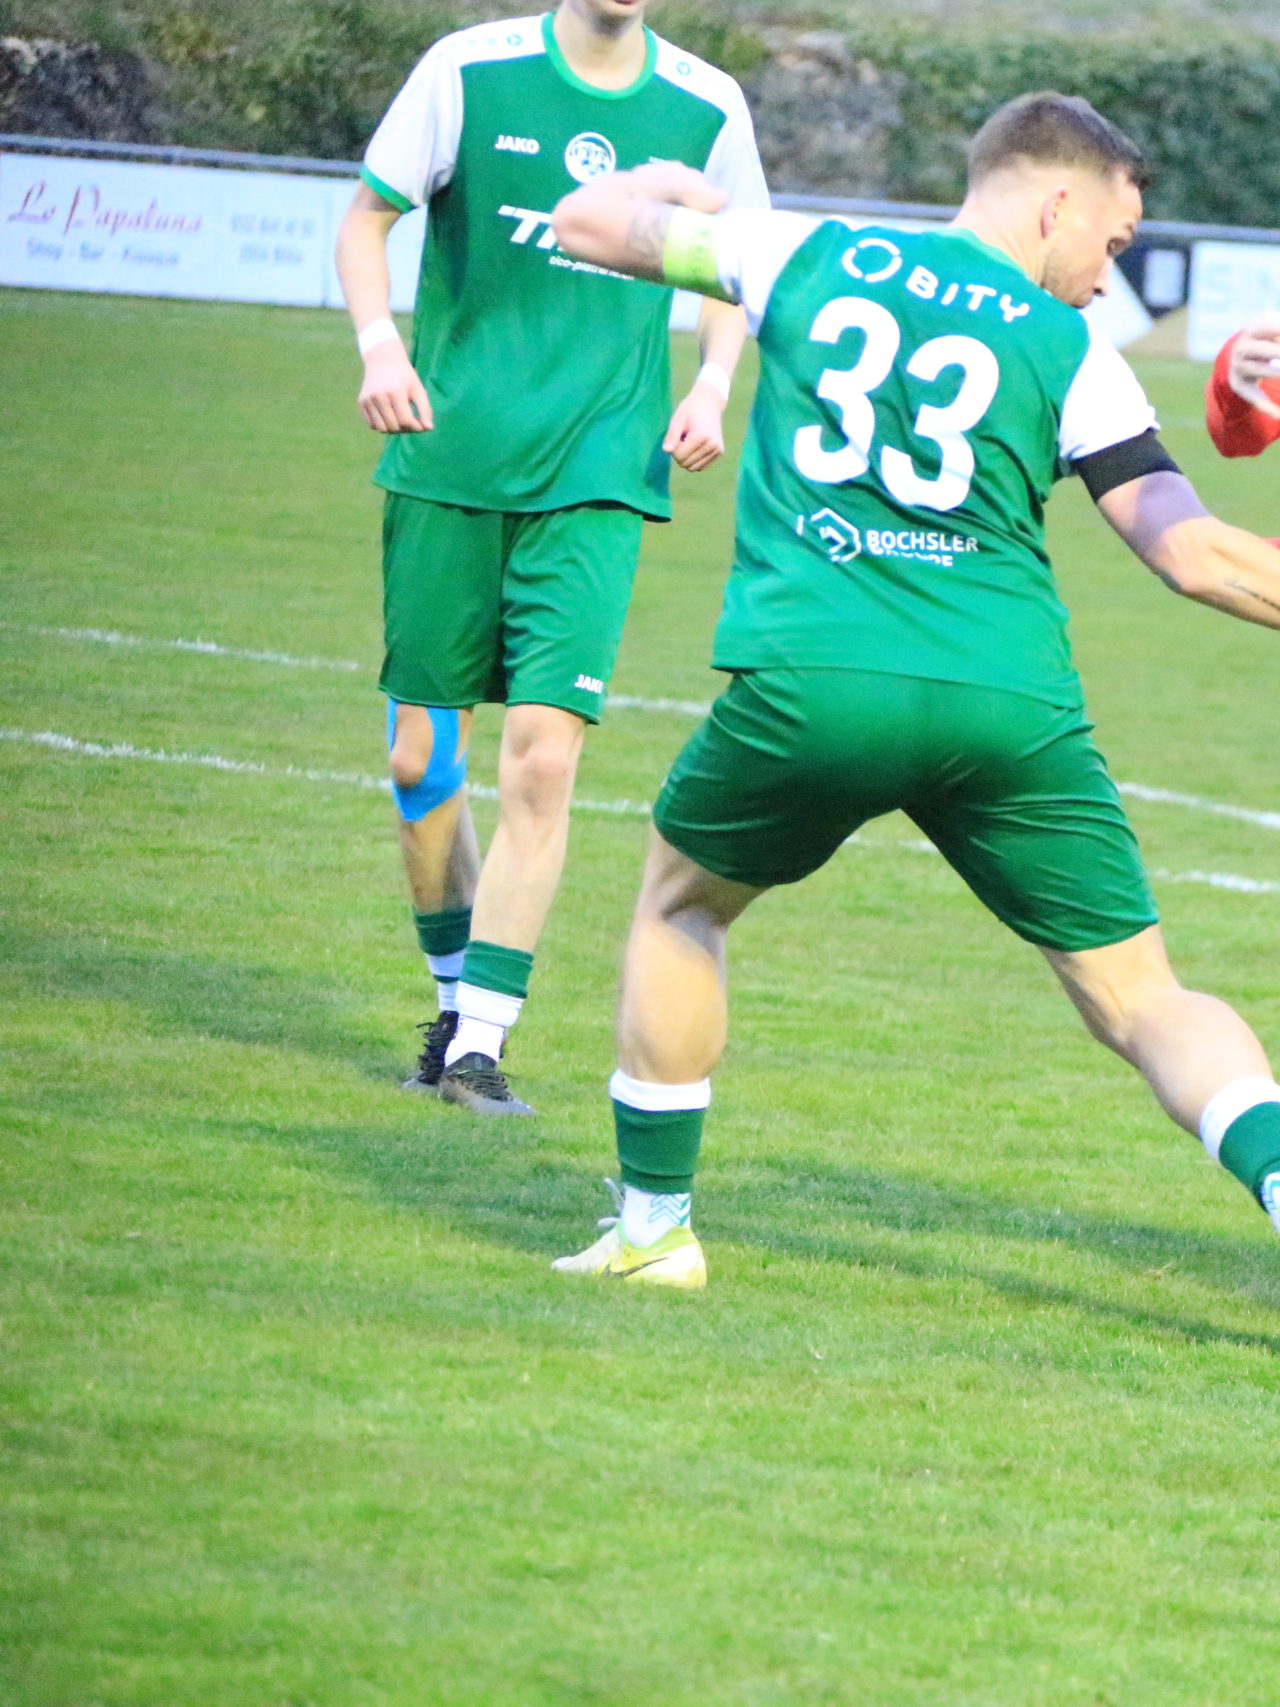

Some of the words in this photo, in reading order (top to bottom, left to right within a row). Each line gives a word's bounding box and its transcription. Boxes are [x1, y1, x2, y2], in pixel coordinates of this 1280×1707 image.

[495, 134, 540, 155] JAKO
[793, 296, 1000, 512] 33
[866, 530, 979, 552] BOCHSLER
